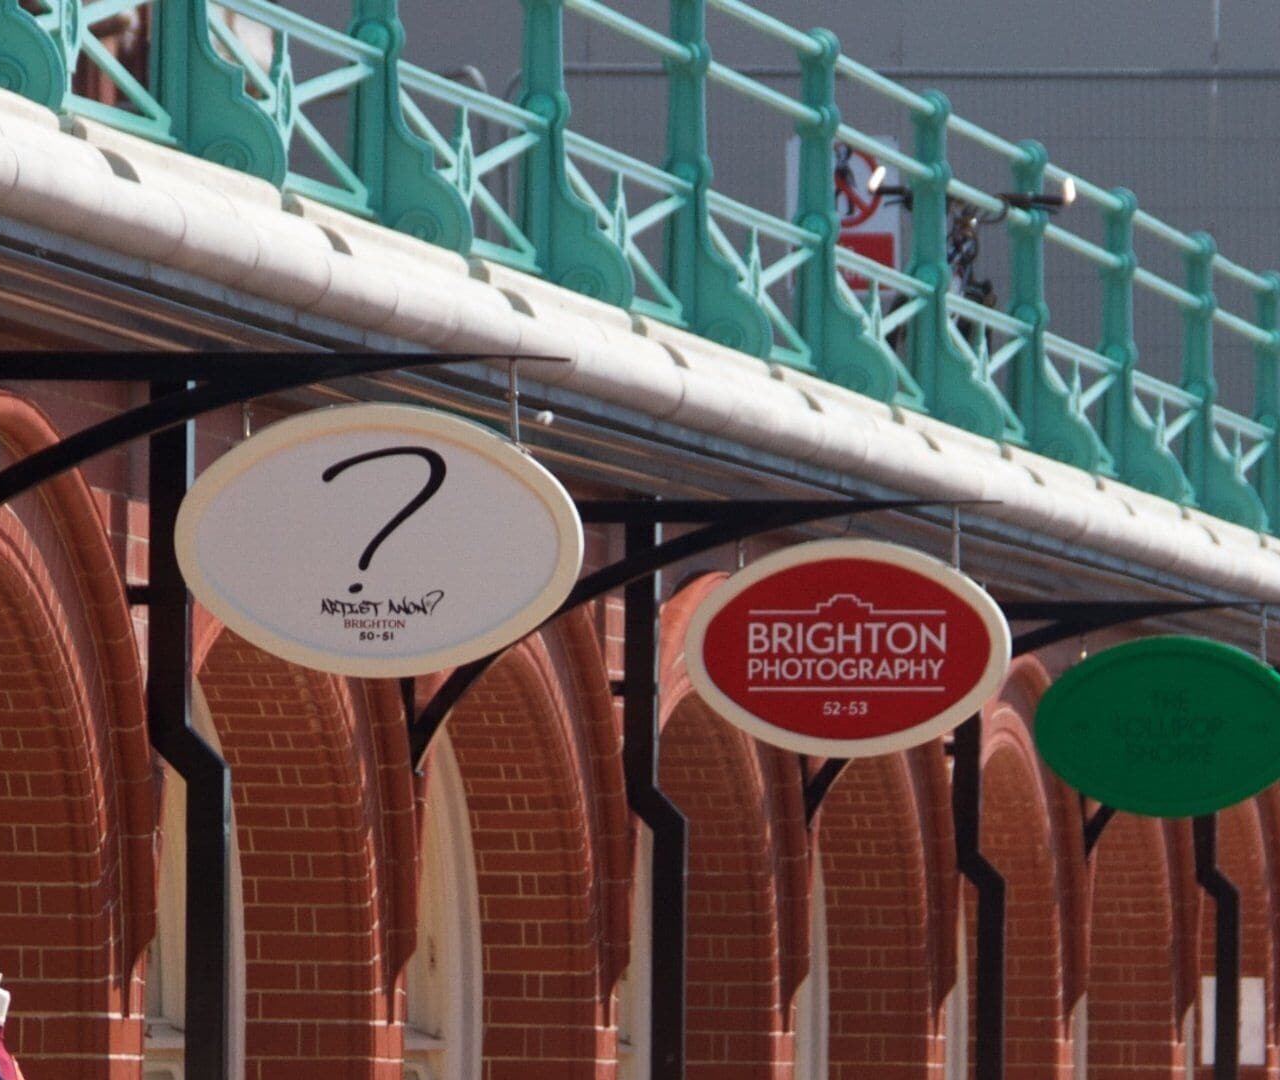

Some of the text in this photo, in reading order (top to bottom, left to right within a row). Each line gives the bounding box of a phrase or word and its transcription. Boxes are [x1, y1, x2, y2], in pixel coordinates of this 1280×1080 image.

[343, 619, 406, 629] BRIGHTON
[359, 631, 394, 641] 50-51
[748, 622, 947, 654] BRIGHTON
[748, 658, 945, 680] PHOTOGRAPHY
[823, 701, 868, 716] 52-53
